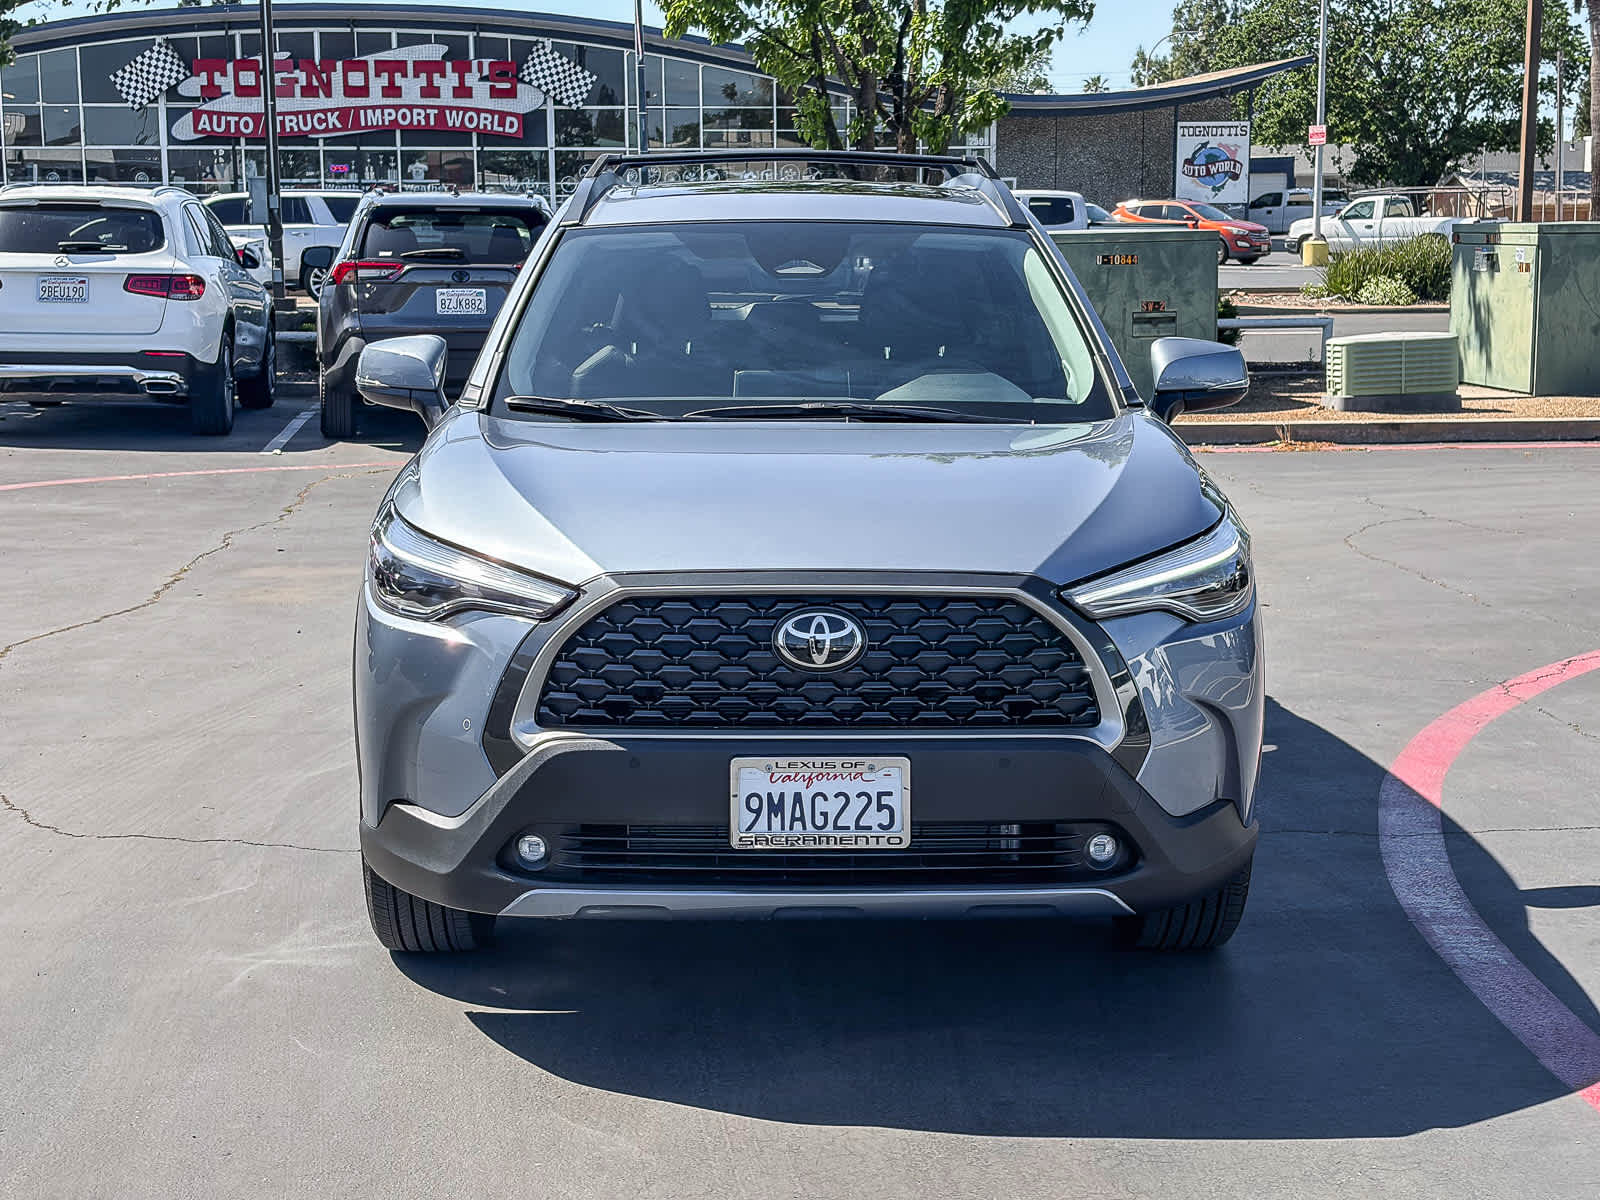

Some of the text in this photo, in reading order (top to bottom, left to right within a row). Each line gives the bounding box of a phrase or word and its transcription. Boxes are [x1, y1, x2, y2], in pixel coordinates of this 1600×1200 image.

[192, 59, 518, 99] TOGNOTTI'S
[197, 113, 254, 134] AUTO
[276, 111, 343, 132] TRUCK
[359, 108, 439, 127] IMPORT
[445, 110, 519, 134] WORLD
[1180, 124, 1249, 137] TOGNOTTI'S
[1182, 161, 1242, 177] AUTO WORLD
[40, 286, 85, 298] 9BEU190
[440, 298, 483, 310] 8ZJK882
[775, 761, 865, 769] LEXUS OF
[769, 771, 876, 789] California
[745, 791, 895, 831] 9MAG225
[738, 835, 904, 846] SACRAMENTO
